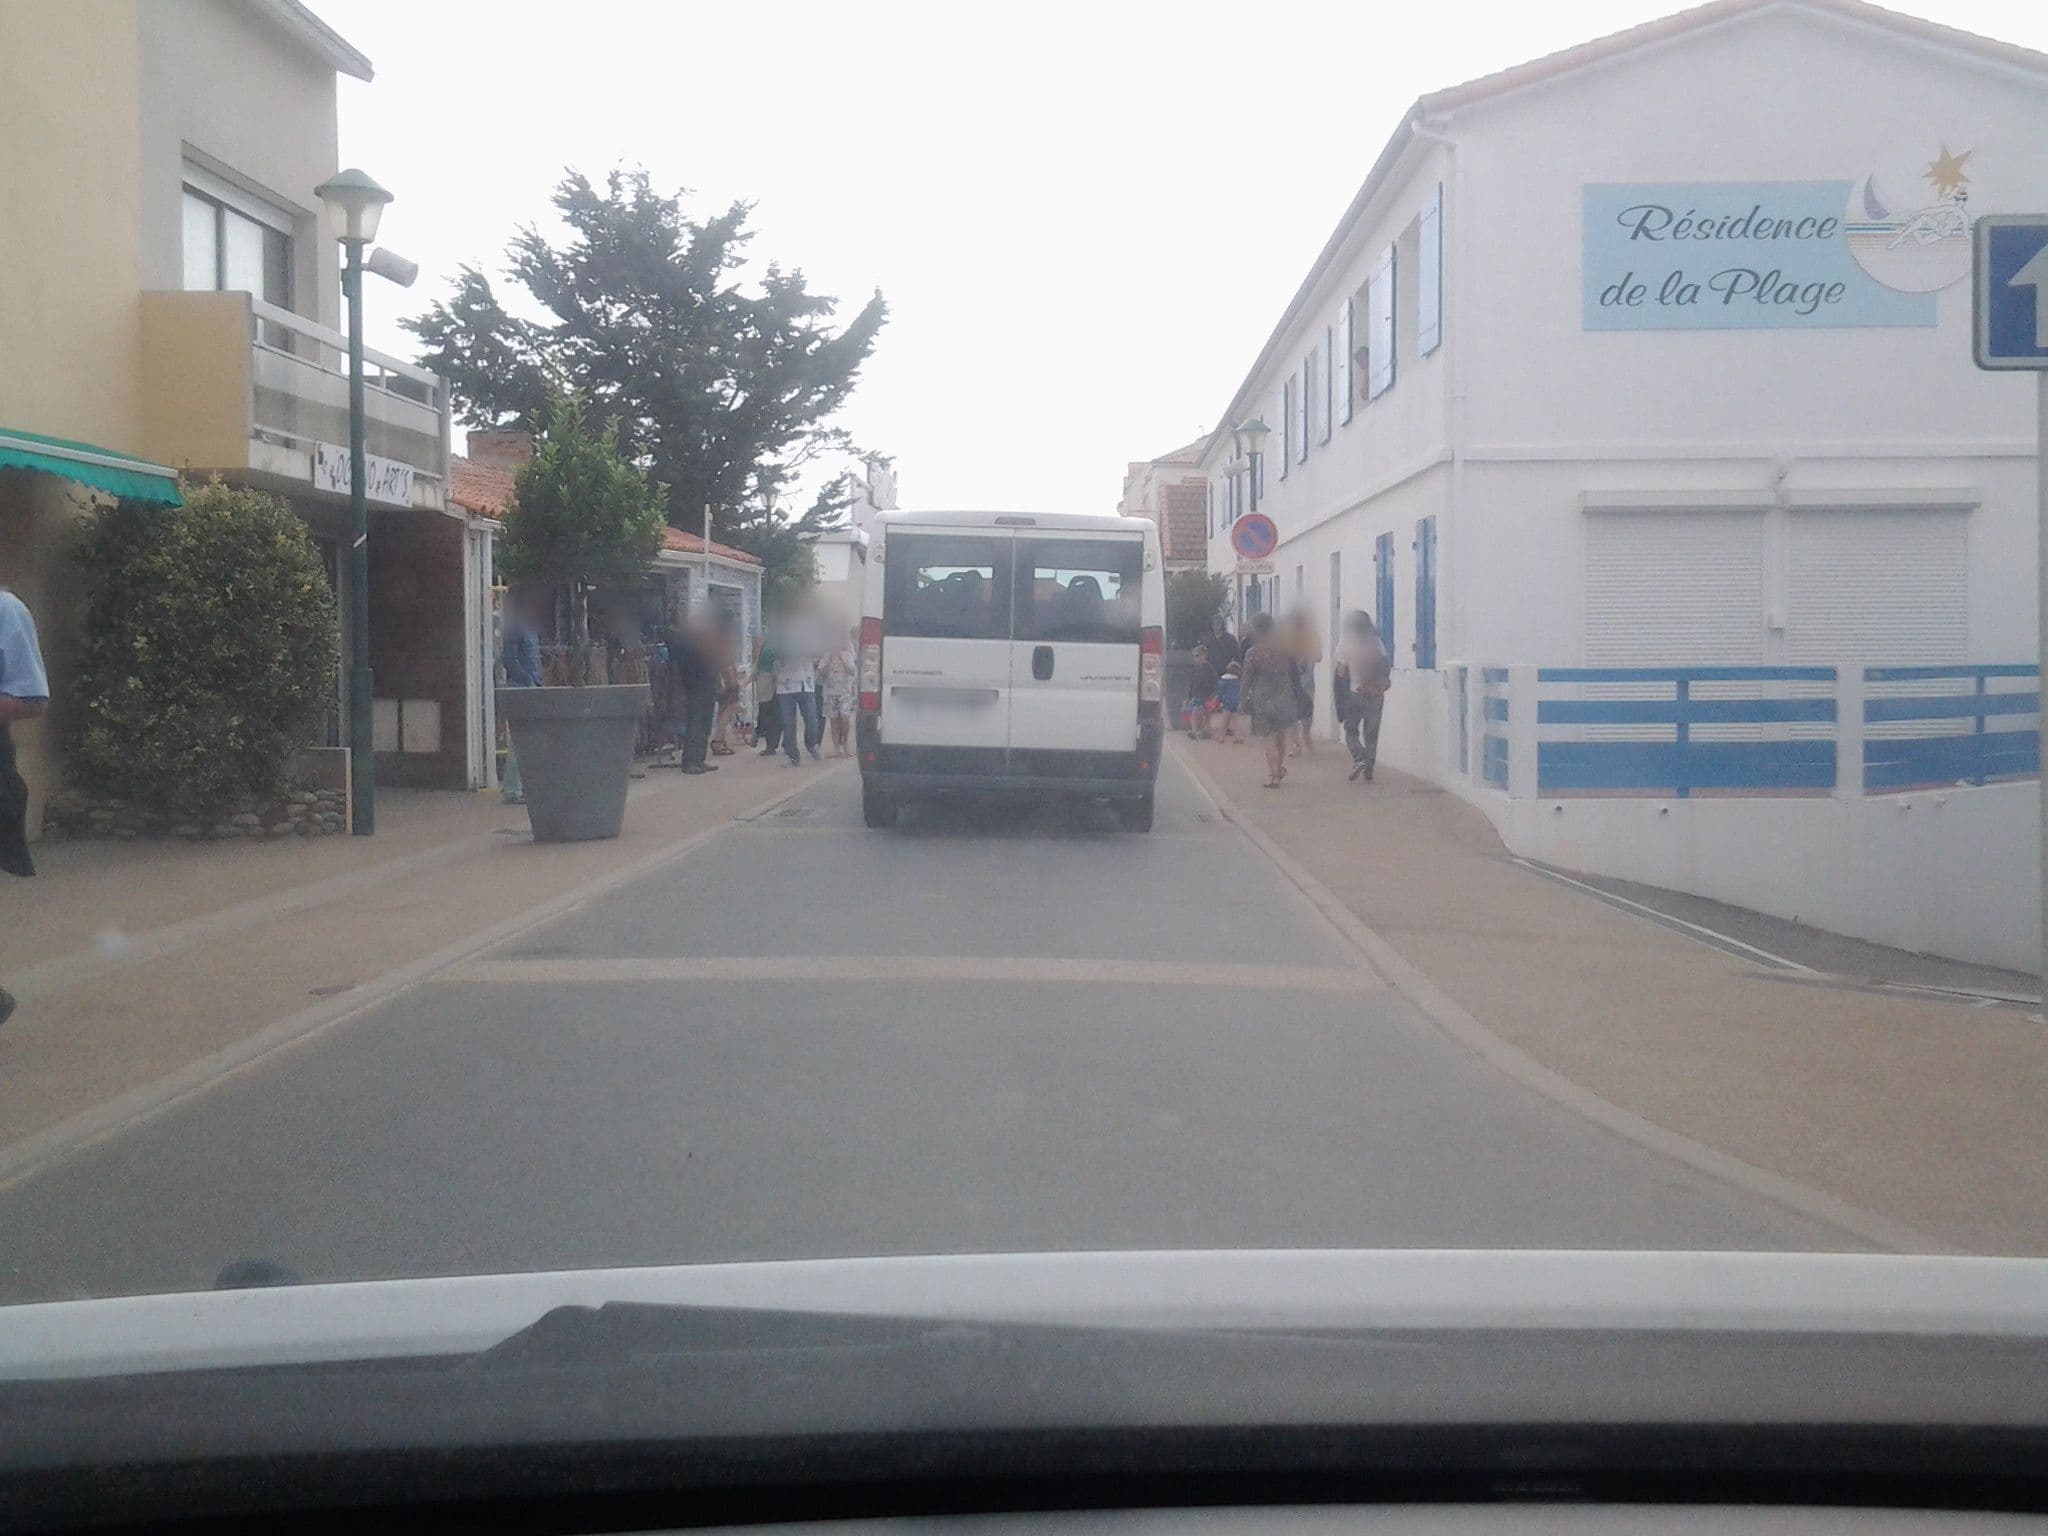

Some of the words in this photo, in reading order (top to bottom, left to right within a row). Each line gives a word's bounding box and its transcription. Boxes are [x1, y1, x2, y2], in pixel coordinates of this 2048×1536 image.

[1617, 204, 1838, 242] Résidence
[1600, 271, 1647, 307] de
[1655, 269, 1701, 306] la
[1708, 268, 1846, 315] Plage
